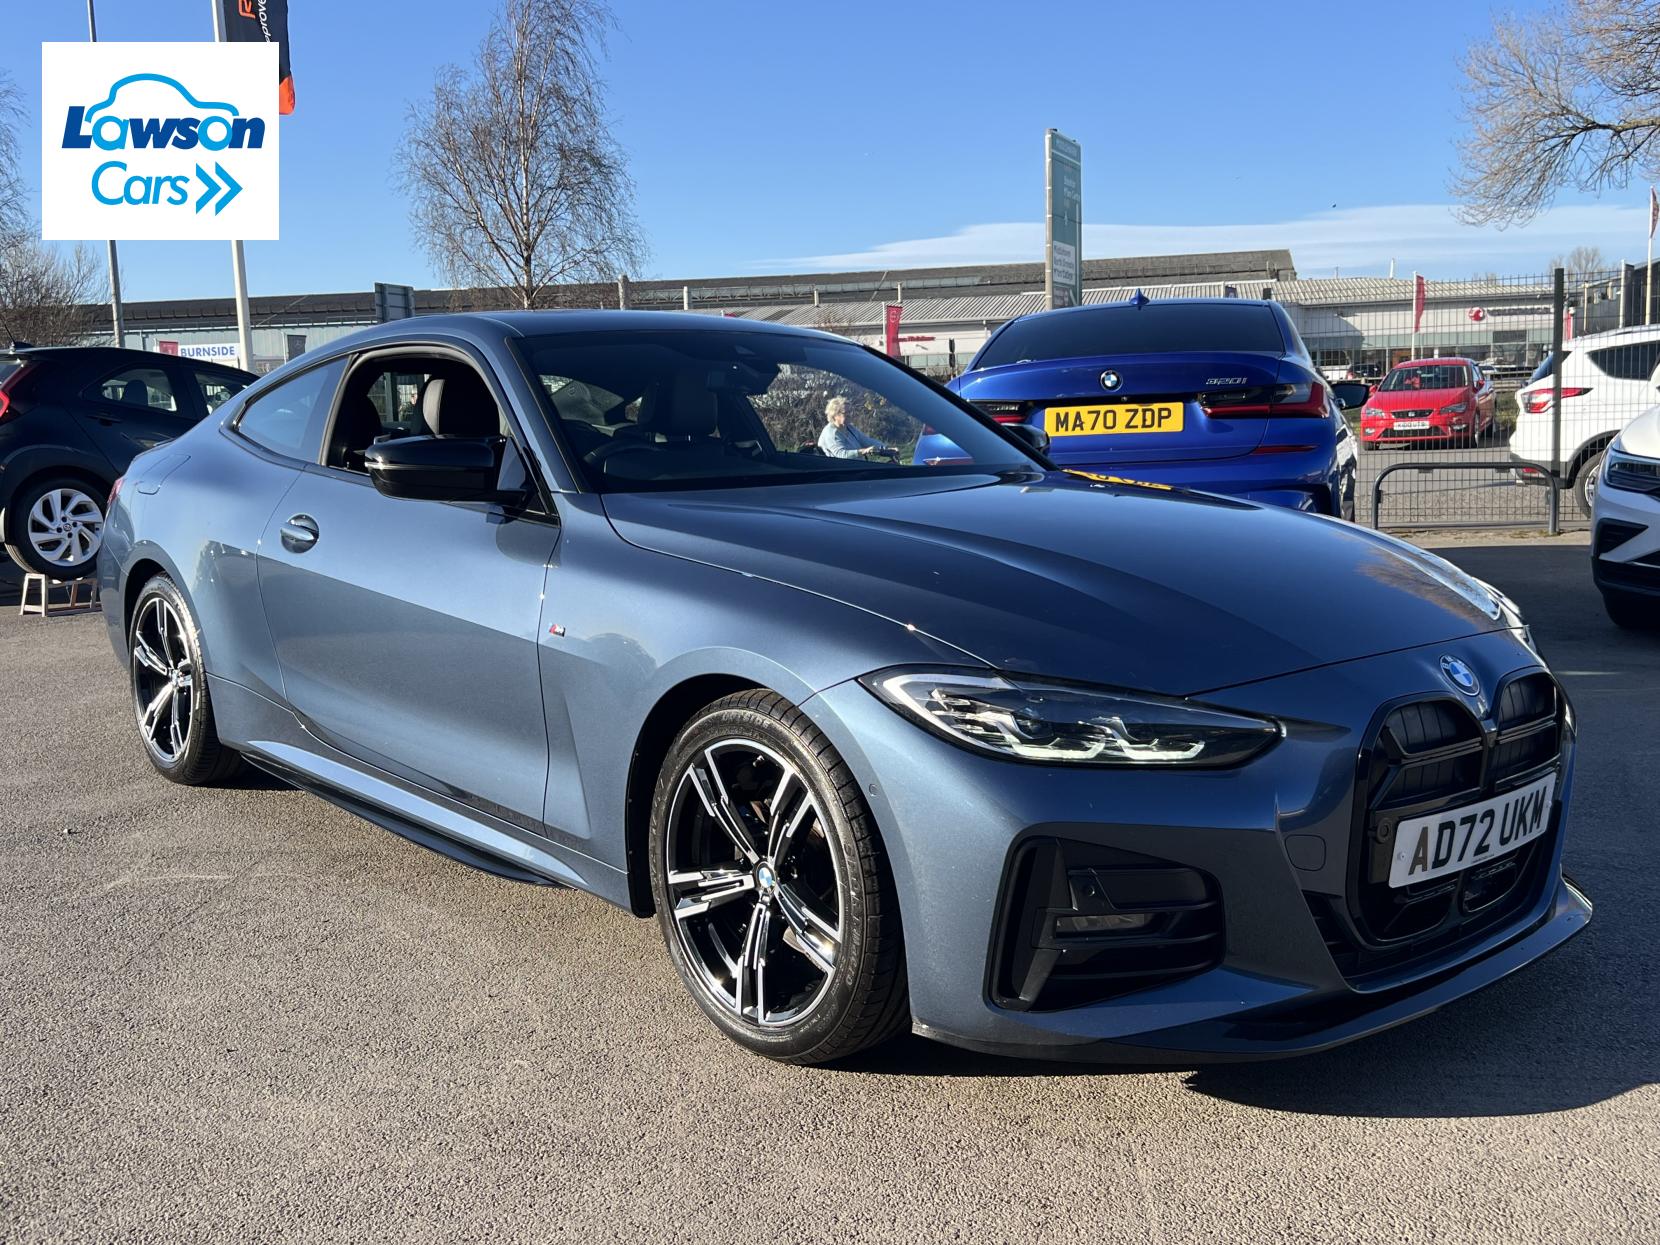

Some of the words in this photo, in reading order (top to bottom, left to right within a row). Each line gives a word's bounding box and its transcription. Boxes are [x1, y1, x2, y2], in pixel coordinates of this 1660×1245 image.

[180, 346, 235, 358] BURNSIDE
[1054, 408, 1117, 433] MA70
[1124, 407, 1172, 430] ZDP
[1408, 808, 1495, 876] AD72
[1499, 787, 1546, 846] UKM
